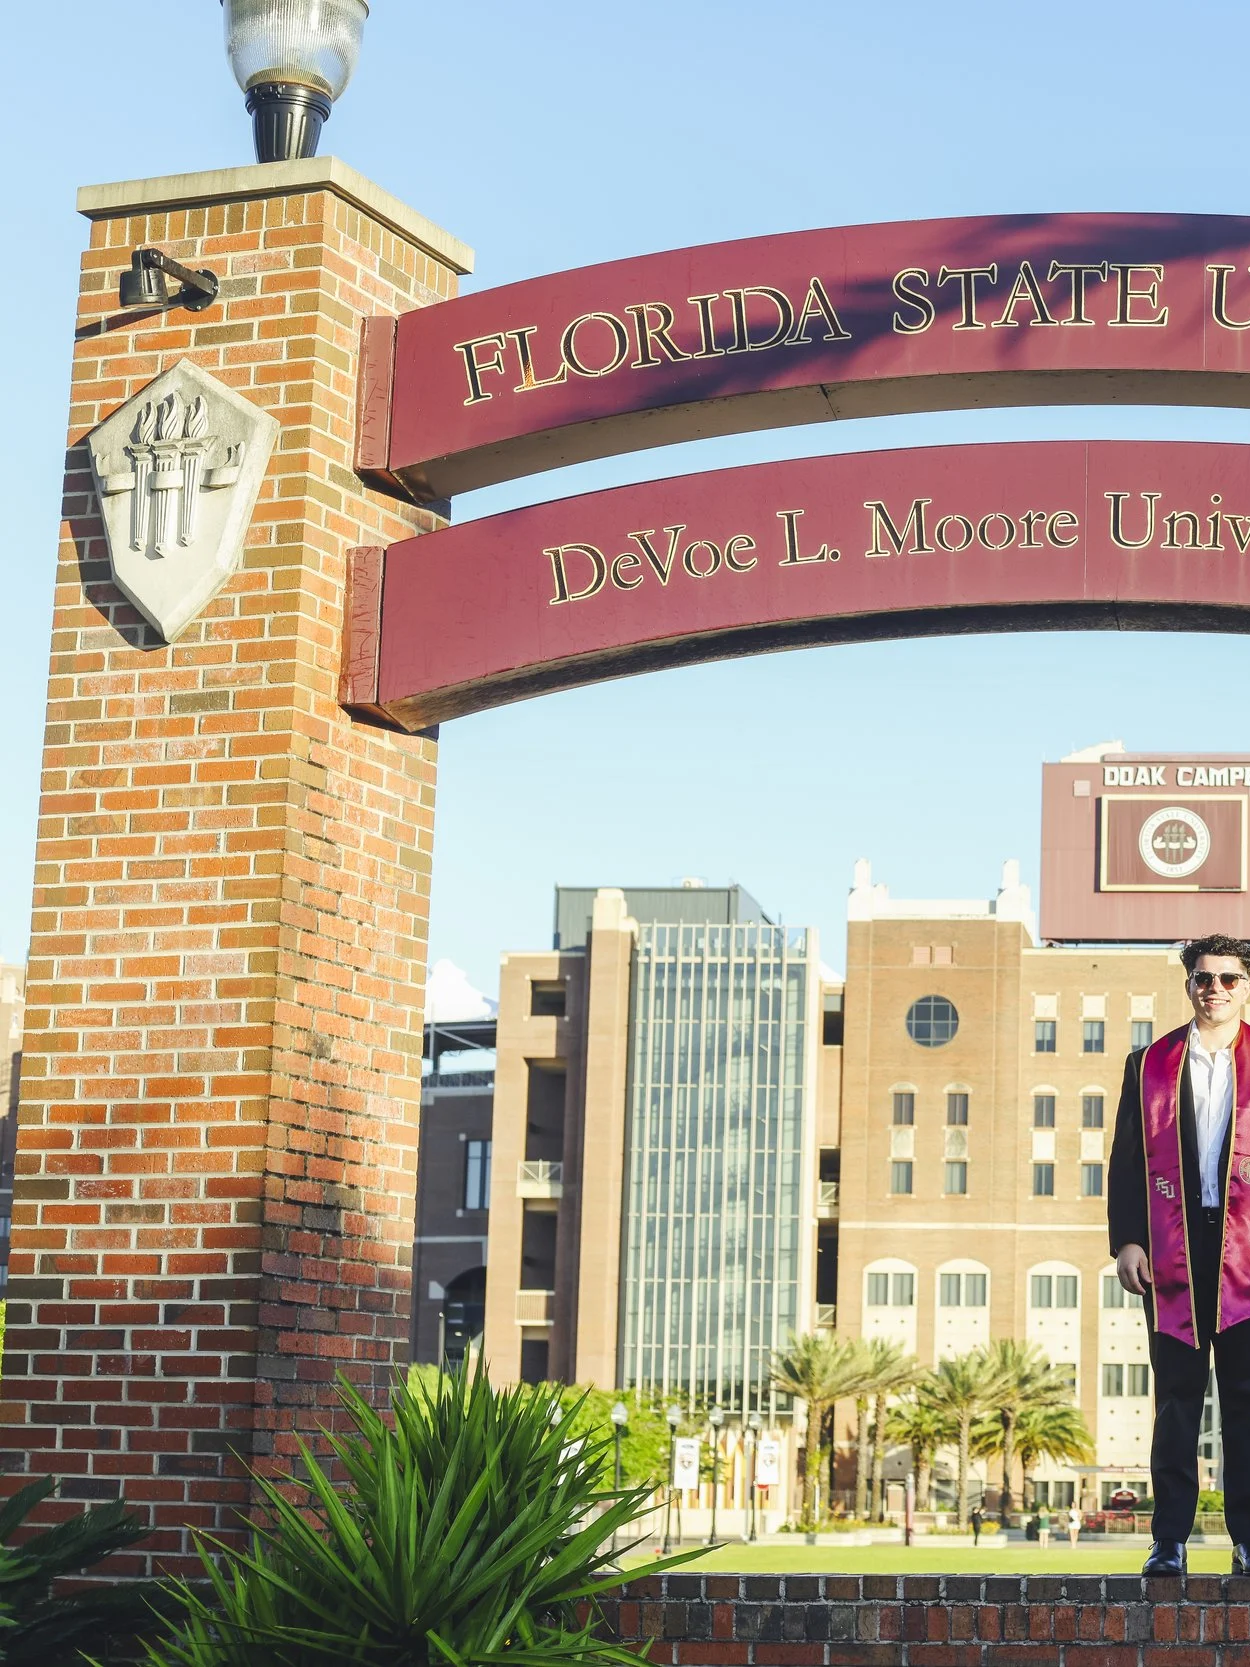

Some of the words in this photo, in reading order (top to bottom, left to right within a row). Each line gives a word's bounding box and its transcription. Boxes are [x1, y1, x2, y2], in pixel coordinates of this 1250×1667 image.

[453, 277, 852, 406] FLORIDA
[892, 259, 1169, 334] STATE
[542, 523, 757, 606] DeVoe
[776, 508, 840, 567] L.
[863, 498, 1079, 558] Moore
[1103, 766, 1167, 787] DOAK
[1155, 1176, 1176, 1198] FSU
